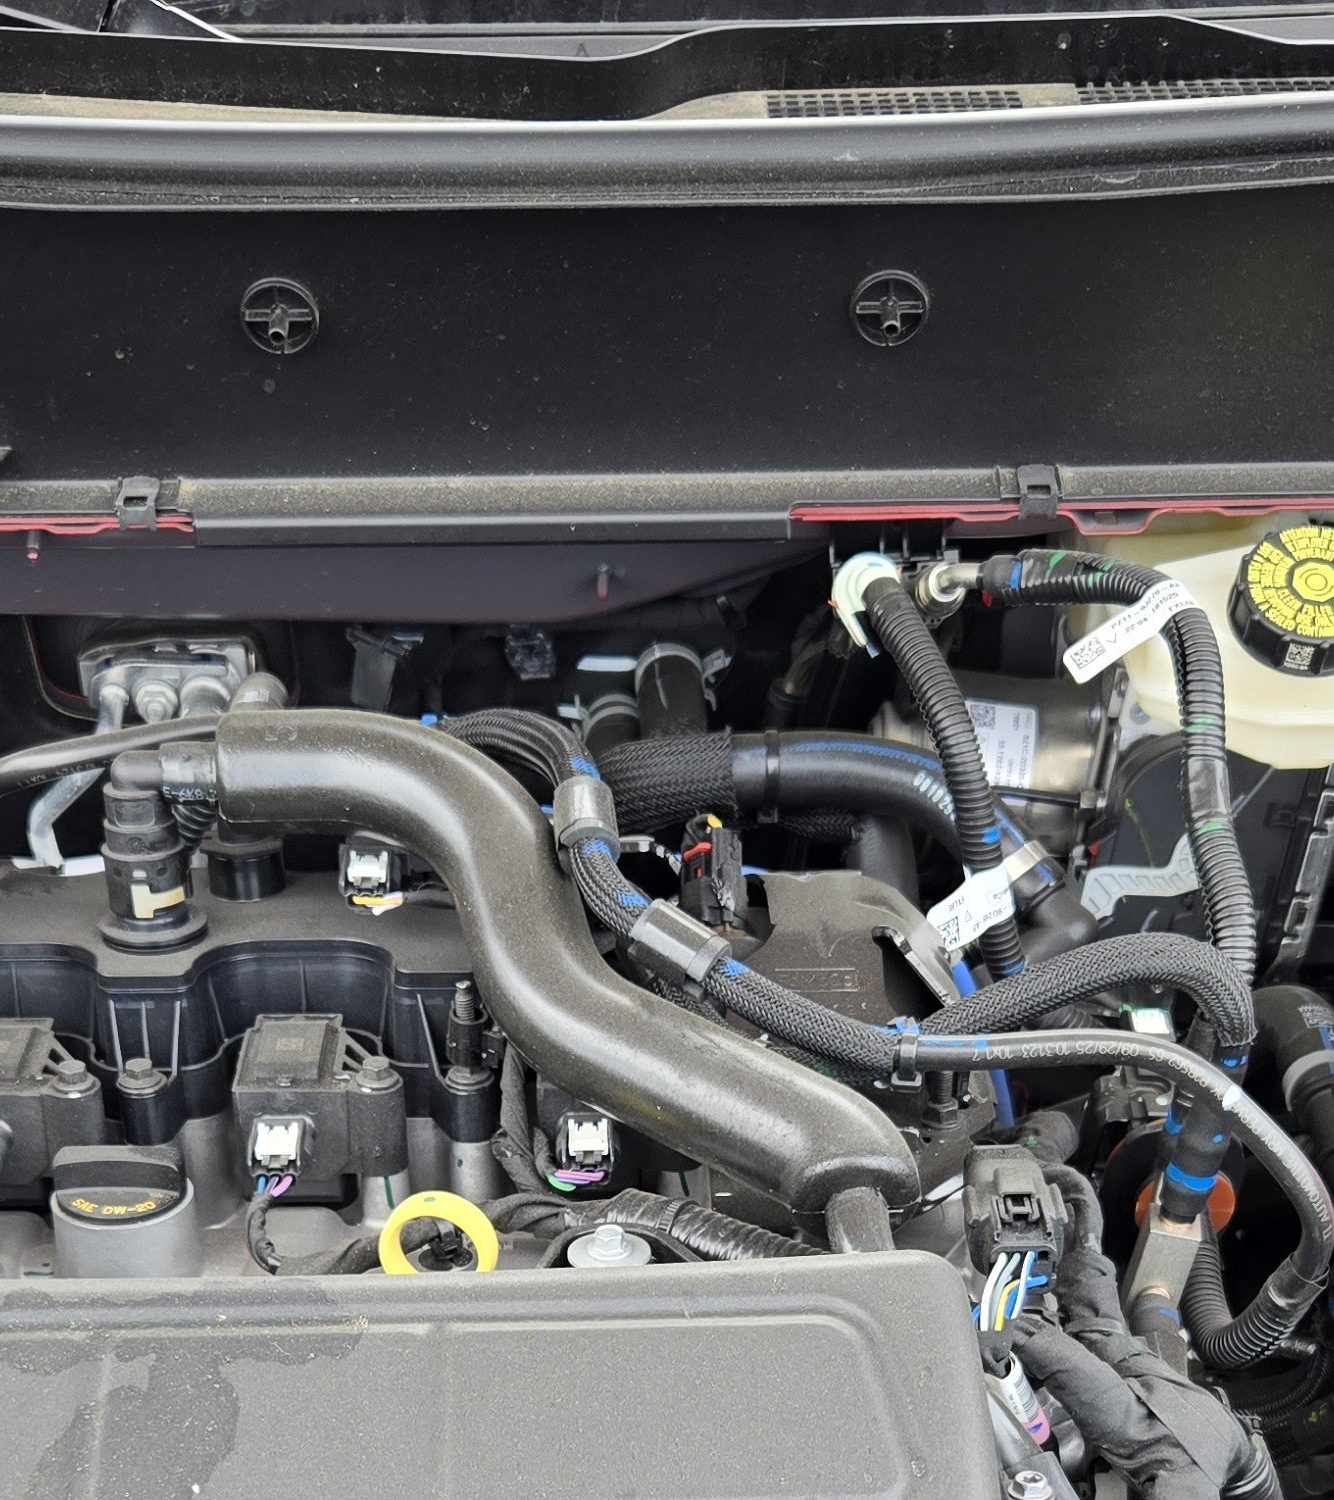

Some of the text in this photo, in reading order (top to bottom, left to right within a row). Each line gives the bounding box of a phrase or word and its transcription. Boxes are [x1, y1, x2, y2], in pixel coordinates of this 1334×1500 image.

[1075, 1040, 1138, 1057] 09/29/25
[1280, 1152, 1331, 1221] AUTOMOTIVE
[72, 1198, 156, 1216] SAE 0W-20
